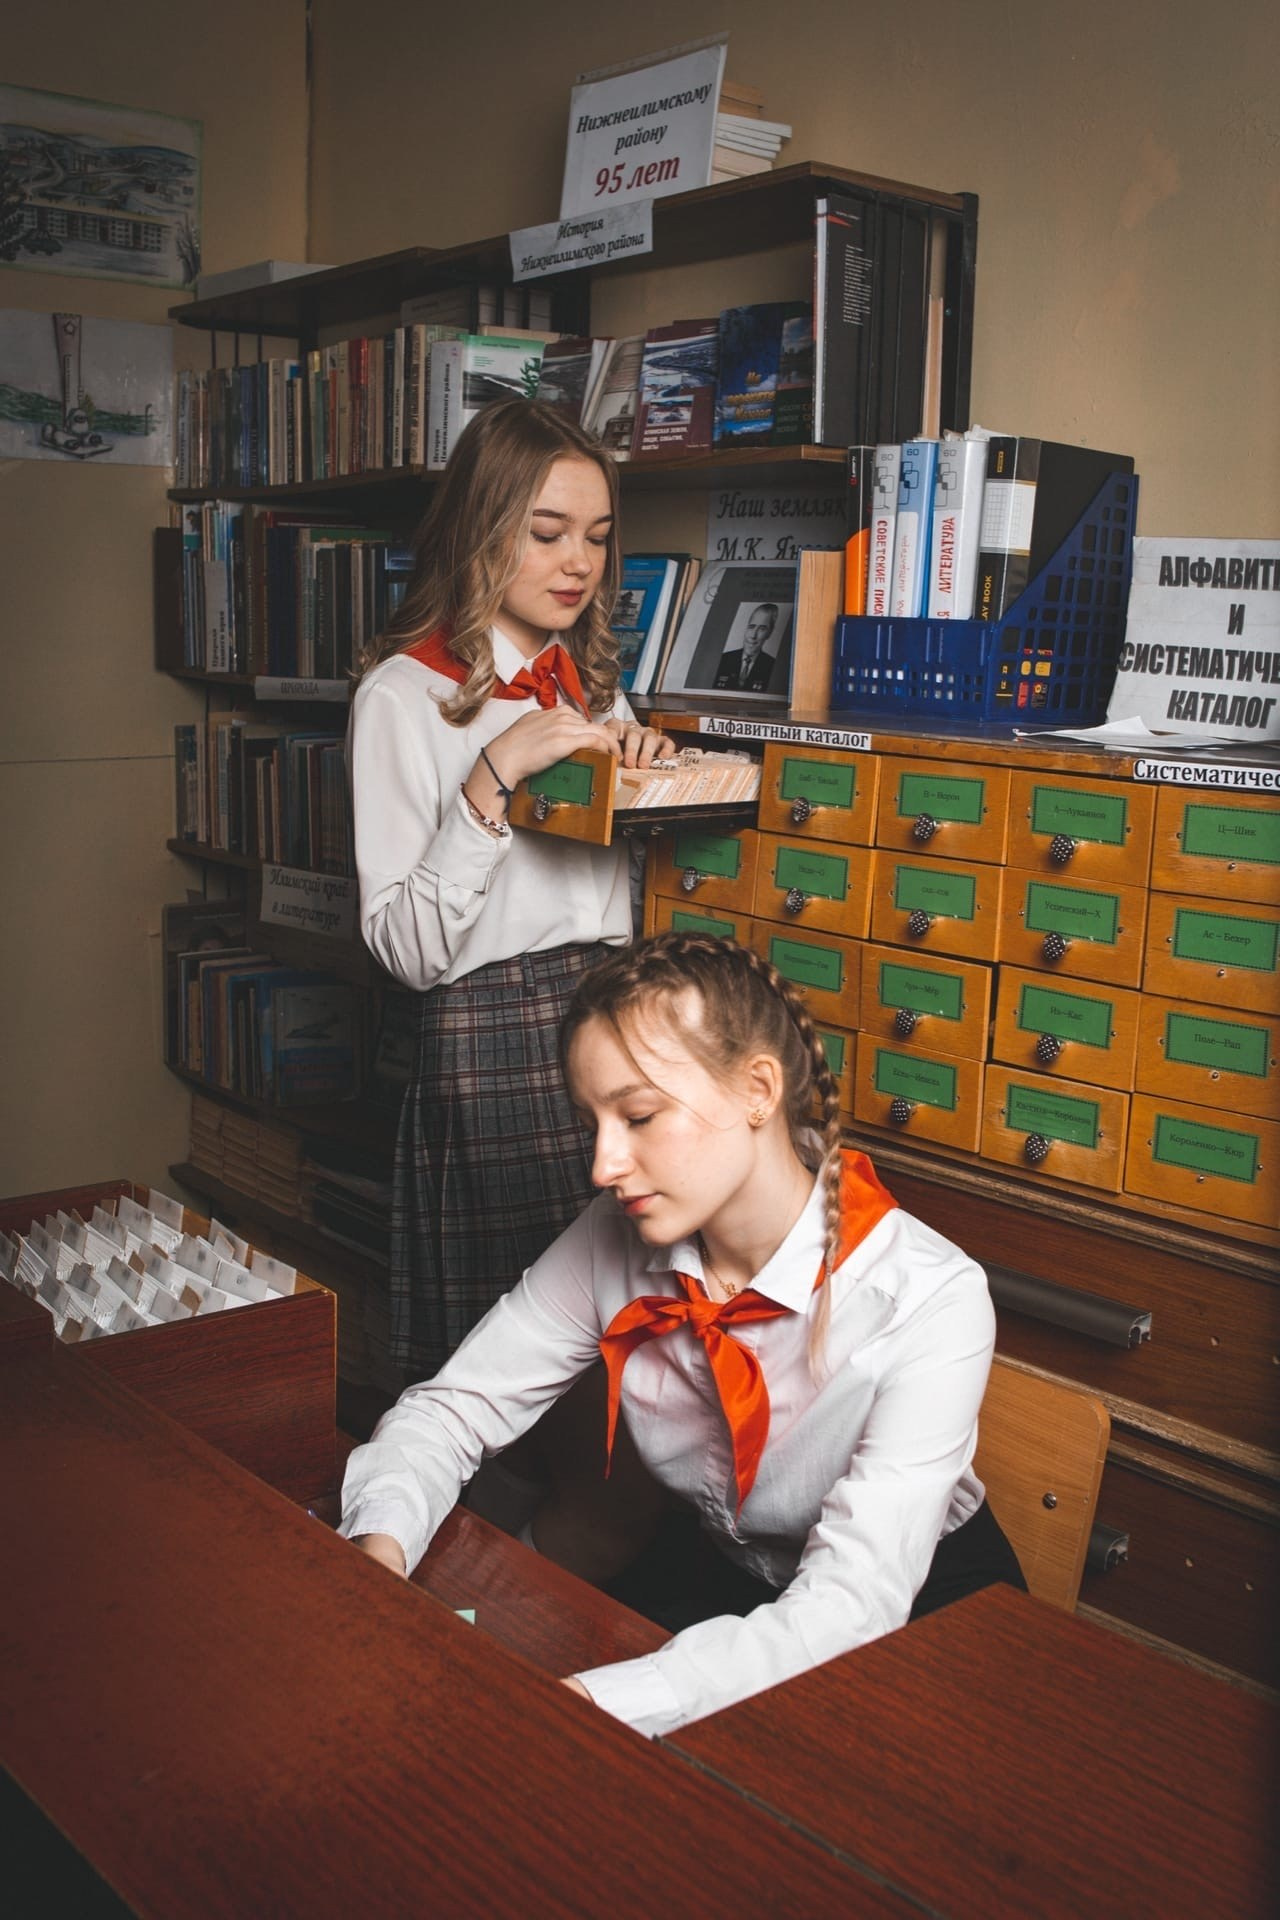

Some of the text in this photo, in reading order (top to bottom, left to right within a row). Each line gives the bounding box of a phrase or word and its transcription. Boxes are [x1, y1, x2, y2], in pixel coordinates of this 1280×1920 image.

[576, 82, 712, 133] Нижнеилимскому
[614, 124, 667, 155] району
[594, 156, 680, 196] 95 лет
[556, 217, 604, 240] История
[520, 232, 645, 272] Нижнеилимского района
[717, 491, 847, 520] Наш земляк
[873, 520, 888, 617] СОВЕТСКИЕ ПИСА
[939, 517, 955, 593] ЛИТЕРАТУРА
[983, 575, 993, 602] BOOK
[1227, 604, 1246, 635] И
[1166, 689, 1277, 729] КАТАЛОГ
[806, 729, 868, 748] каталог
